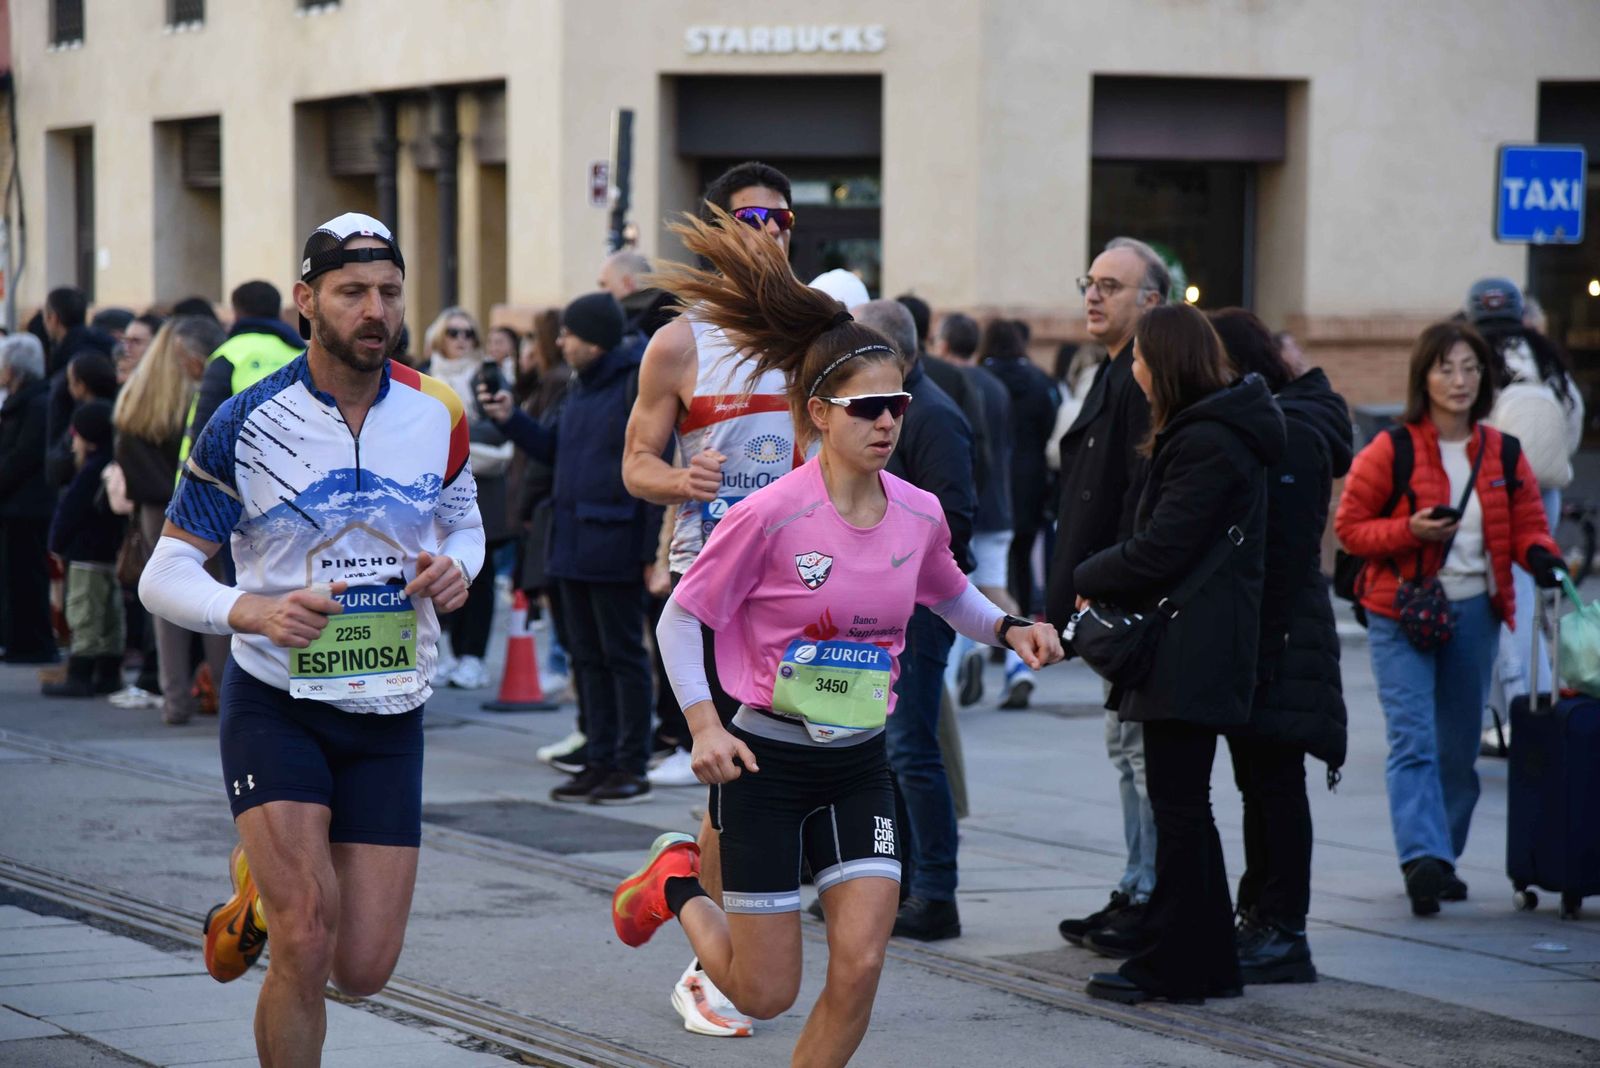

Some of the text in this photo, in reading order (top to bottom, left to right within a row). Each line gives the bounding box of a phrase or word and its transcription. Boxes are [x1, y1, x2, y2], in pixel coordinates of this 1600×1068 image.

[685, 25, 886, 53] STARBUCKS
[1503, 177, 1580, 211] TAXI
[321, 557, 397, 569] PINCHO
[334, 593, 402, 608] ZURICH
[852, 615, 878, 625] Banco
[335, 626, 371, 642] 2255
[845, 626, 903, 639] Santander
[298, 646, 409, 674] ESPINOSA
[820, 648, 879, 664] ZURICH
[815, 677, 849, 694] 3450
[873, 815, 894, 830] THE
[874, 828, 895, 843] COR
[873, 840, 896, 855] NER
